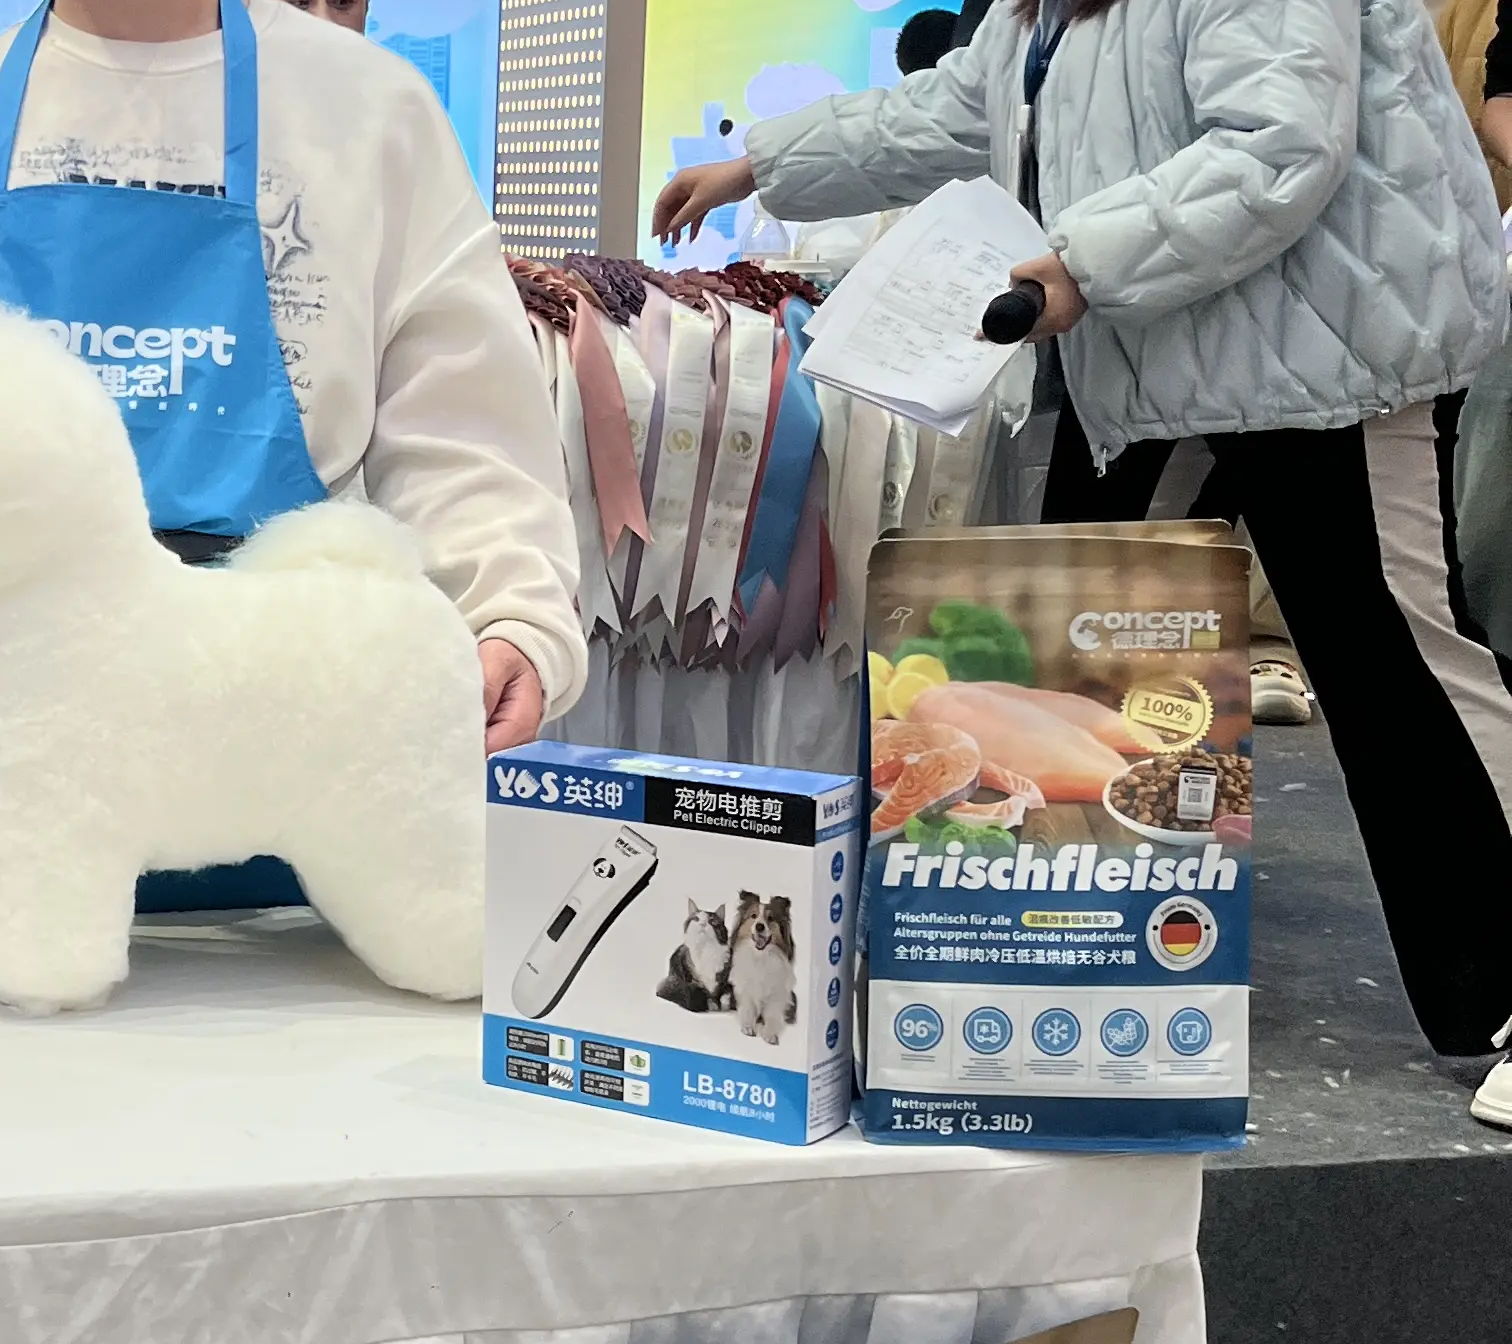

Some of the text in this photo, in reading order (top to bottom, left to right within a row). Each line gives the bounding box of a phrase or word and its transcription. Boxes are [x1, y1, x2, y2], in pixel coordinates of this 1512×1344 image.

[1142, 696, 1193, 722] 100%
[674, 786, 784, 822] 宠物电推剪
[673, 809, 783, 835] Pet Electric Clipper
[882, 840, 1240, 892] Frischfleisch
[894, 912, 1012, 927] Frischfleisch für alle
[893, 928, 1138, 945] Altersgruppen ohne Getreide Hundefutter
[682, 1070, 777, 1108] LB-8780
[891, 1098, 978, 1112] Nettogewicht
[891, 1111, 1034, 1135] 1.5kg (3.3lb)
